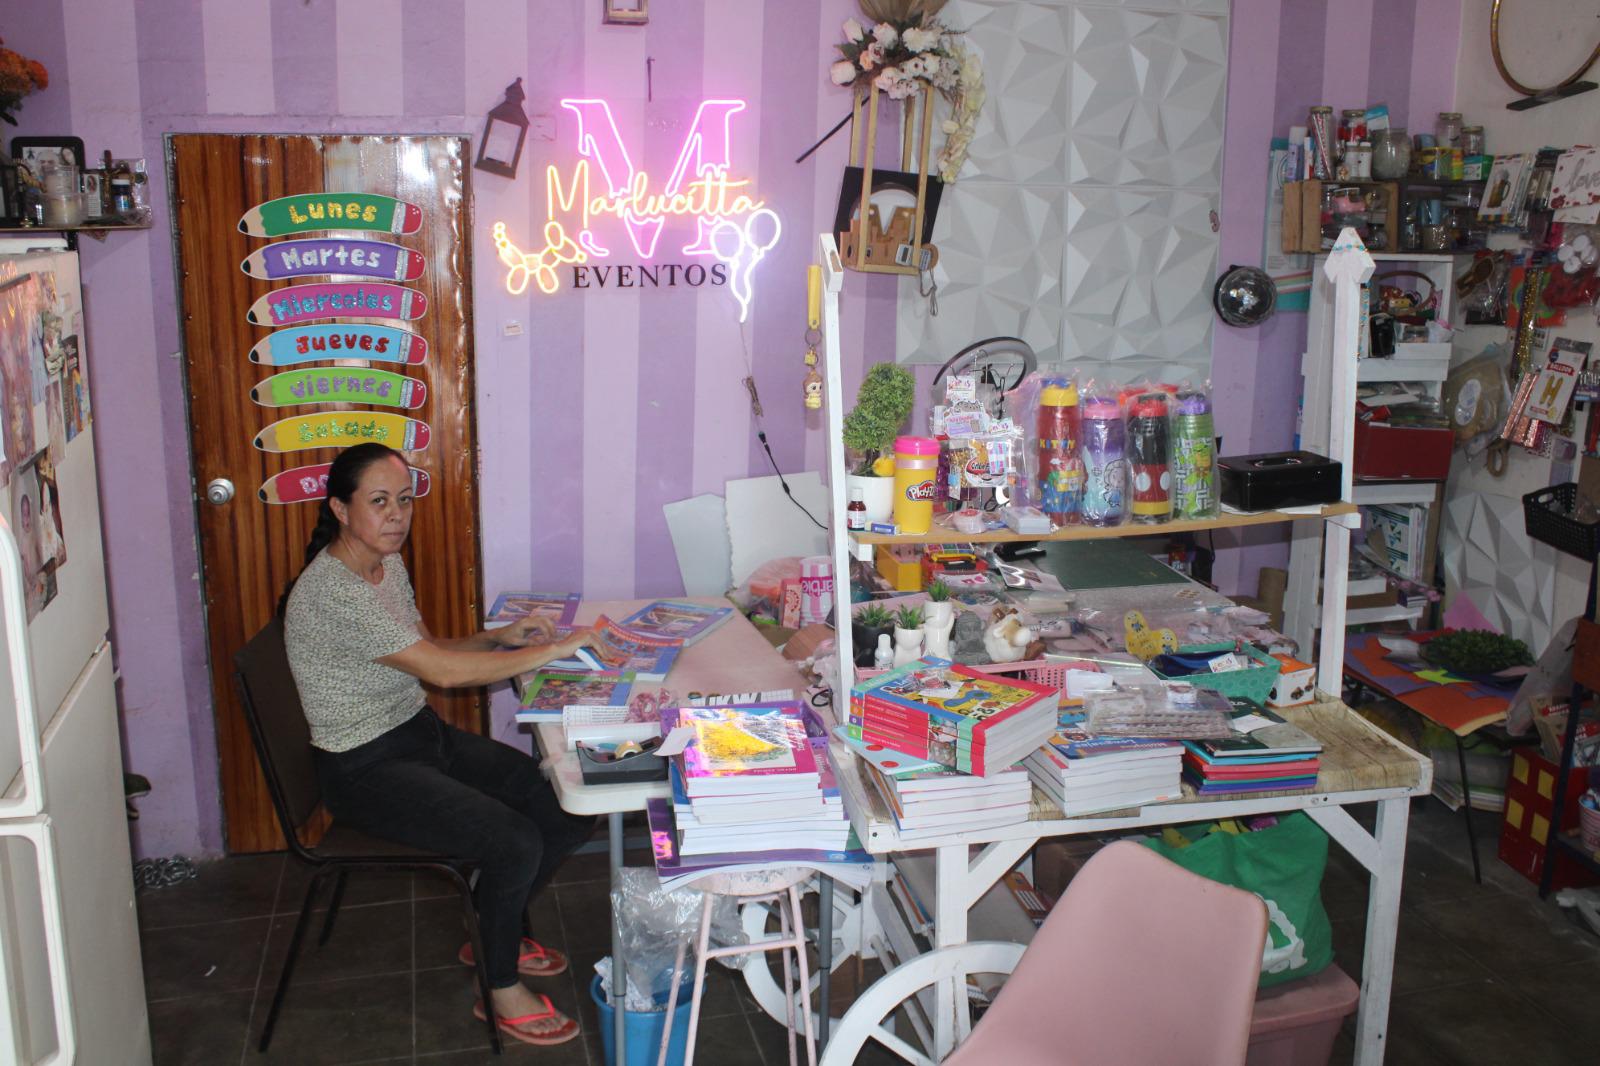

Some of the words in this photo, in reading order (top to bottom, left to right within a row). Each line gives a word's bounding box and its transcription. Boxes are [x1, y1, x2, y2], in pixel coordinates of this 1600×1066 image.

[288, 201, 378, 224] Lunes
[280, 245, 381, 270] Martes
[572, 263, 727, 289] EVENTOS
[272, 288, 393, 321] Miercoles
[295, 333, 391, 355] Jueves
[297, 419, 389, 443] Sabado
[801, 579, 833, 597] arbie
